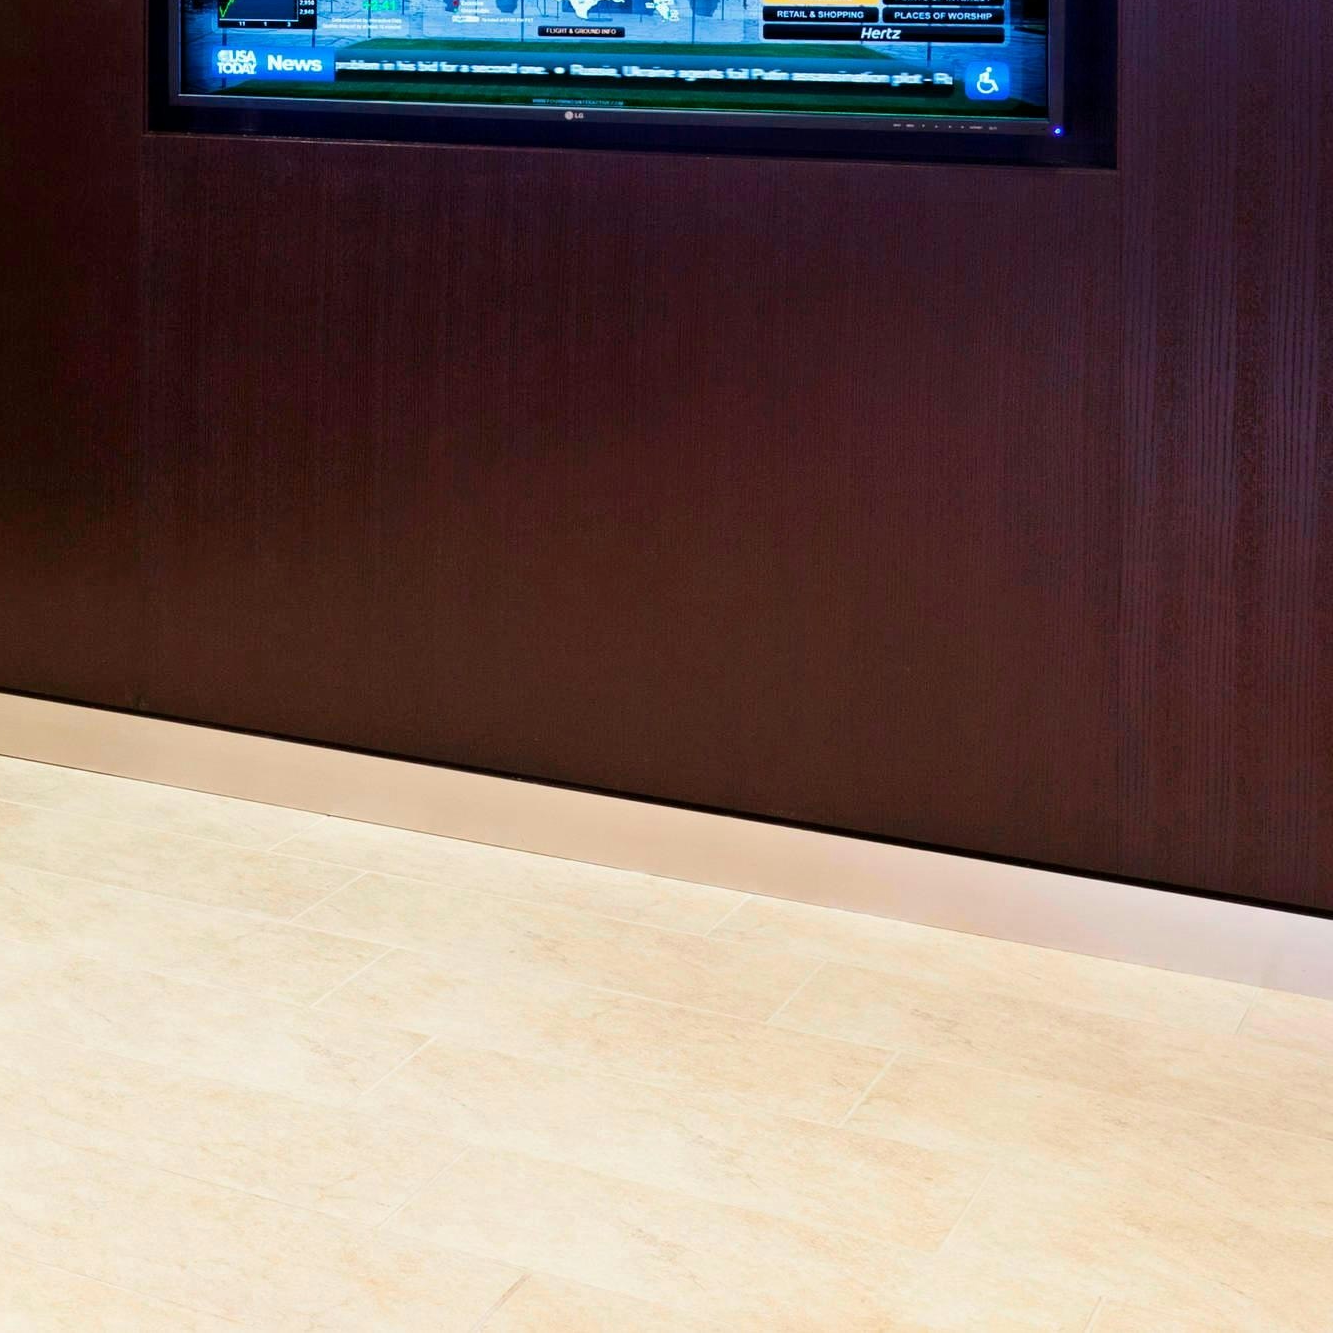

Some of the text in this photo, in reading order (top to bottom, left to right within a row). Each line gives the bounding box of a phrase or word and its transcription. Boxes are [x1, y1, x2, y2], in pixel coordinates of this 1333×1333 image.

[777, 10, 864, 19] RETAIL & SHOPPING
[894, 12, 992, 20] PLACES OF WORSHIP
[861, 27, 901, 40] Hertz
[229, 50, 256, 62] USA
[267, 55, 322, 71] News
